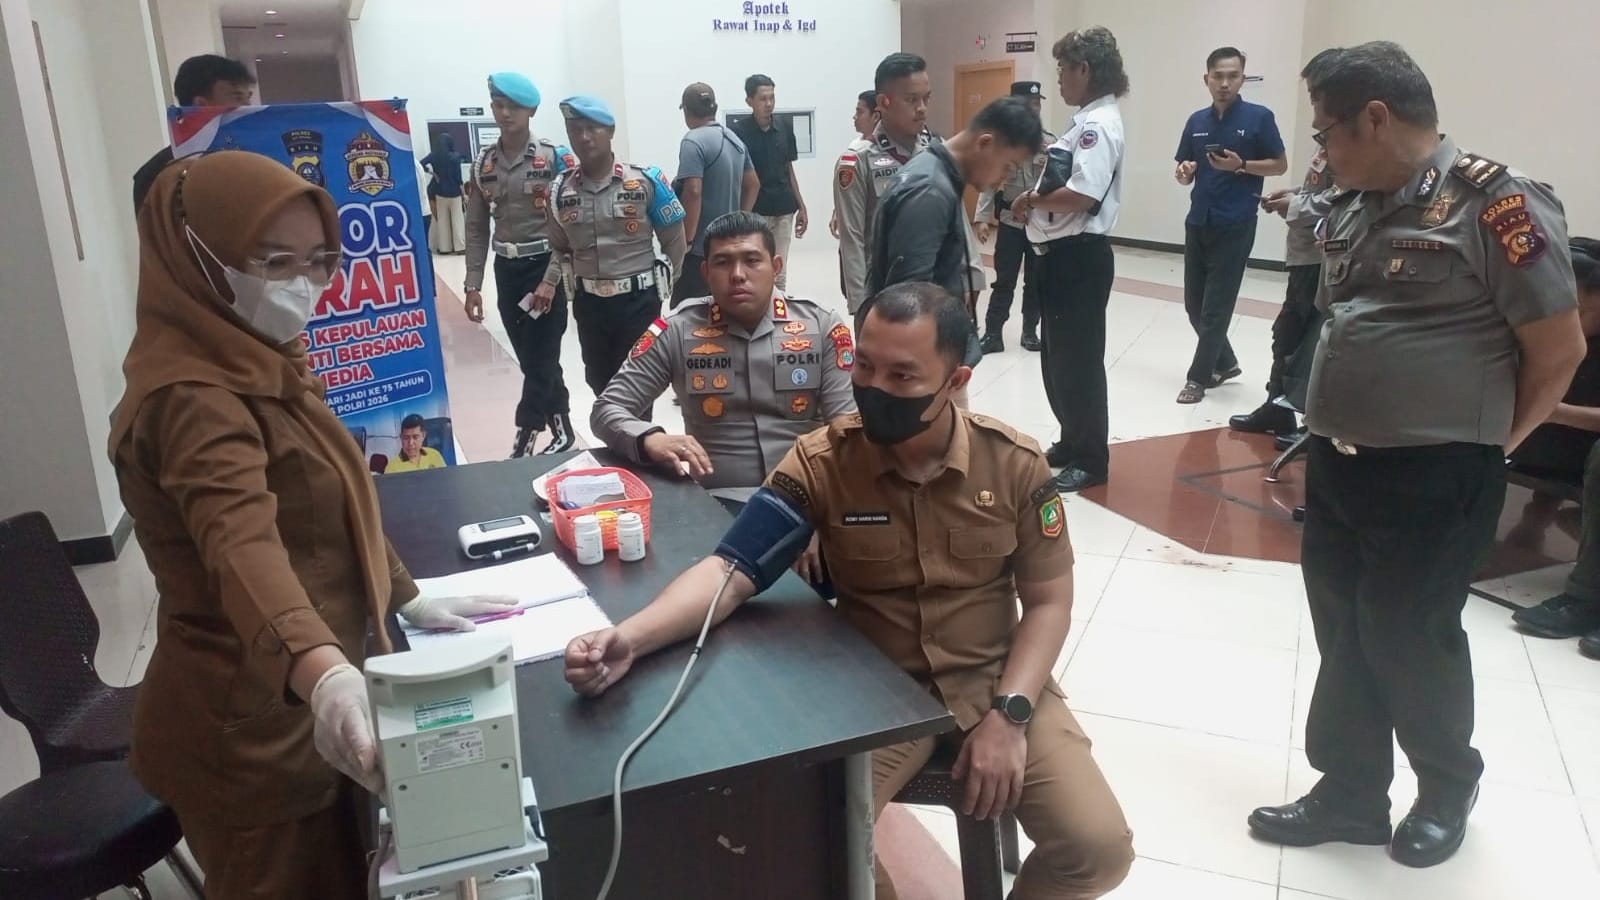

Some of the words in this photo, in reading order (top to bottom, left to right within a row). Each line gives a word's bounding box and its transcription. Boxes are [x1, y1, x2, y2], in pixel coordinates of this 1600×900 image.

[743, 0, 789, 17] Apotek
[713, 19, 748, 31] Rawat
[754, 19, 780, 33] Inap
[782, 19, 793, 31] &
[797, 19, 817, 32] Igd
[617, 191, 645, 200] POLRI
[338, 201, 413, 257] OR
[314, 251, 420, 319] RAH
[313, 309, 427, 347] KEPULAUAN
[306, 348, 334, 371] NTI
[336, 331, 424, 366] BERSAMA
[776, 353, 819, 365] POLRI
[686, 358, 731, 369] GEDEADI
[324, 395, 343, 406] ARI
[344, 391, 367, 402] JADI
[368, 387, 381, 395] KE
[382, 384, 393, 392] 75
[395, 376, 424, 388] TAHUN
[338, 401, 365, 413] POLRI
[368, 394, 388, 406] 2026
